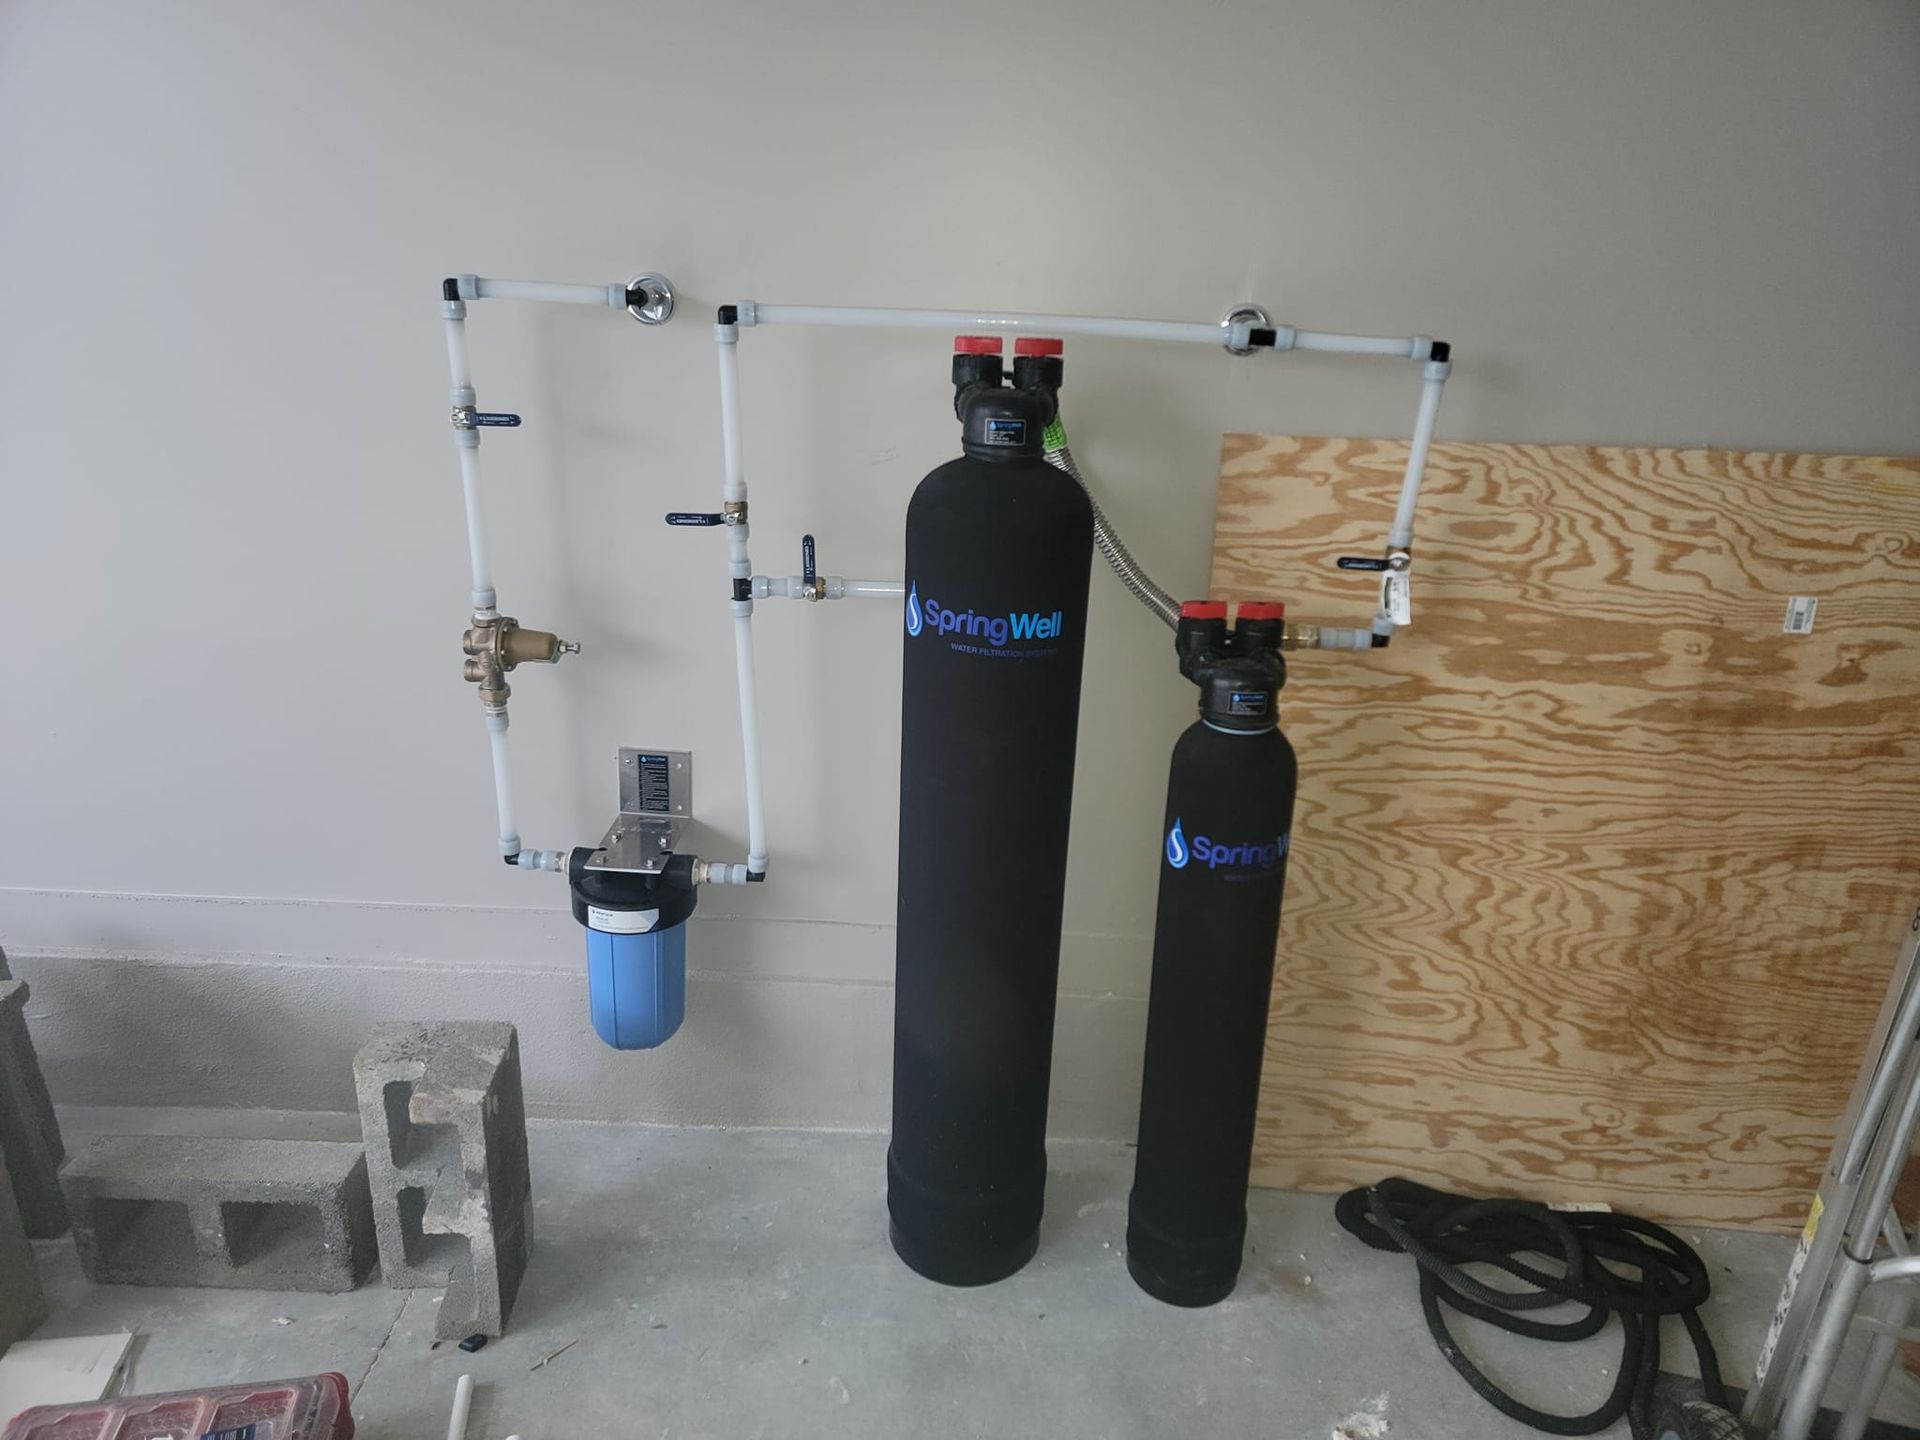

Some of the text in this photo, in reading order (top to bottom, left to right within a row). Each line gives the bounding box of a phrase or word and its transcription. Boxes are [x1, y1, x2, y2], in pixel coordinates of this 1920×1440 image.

[925, 599, 1062, 646] SpringWell
[951, 642, 978, 655] WATER
[979, 647, 1024, 658] FILTRATION
